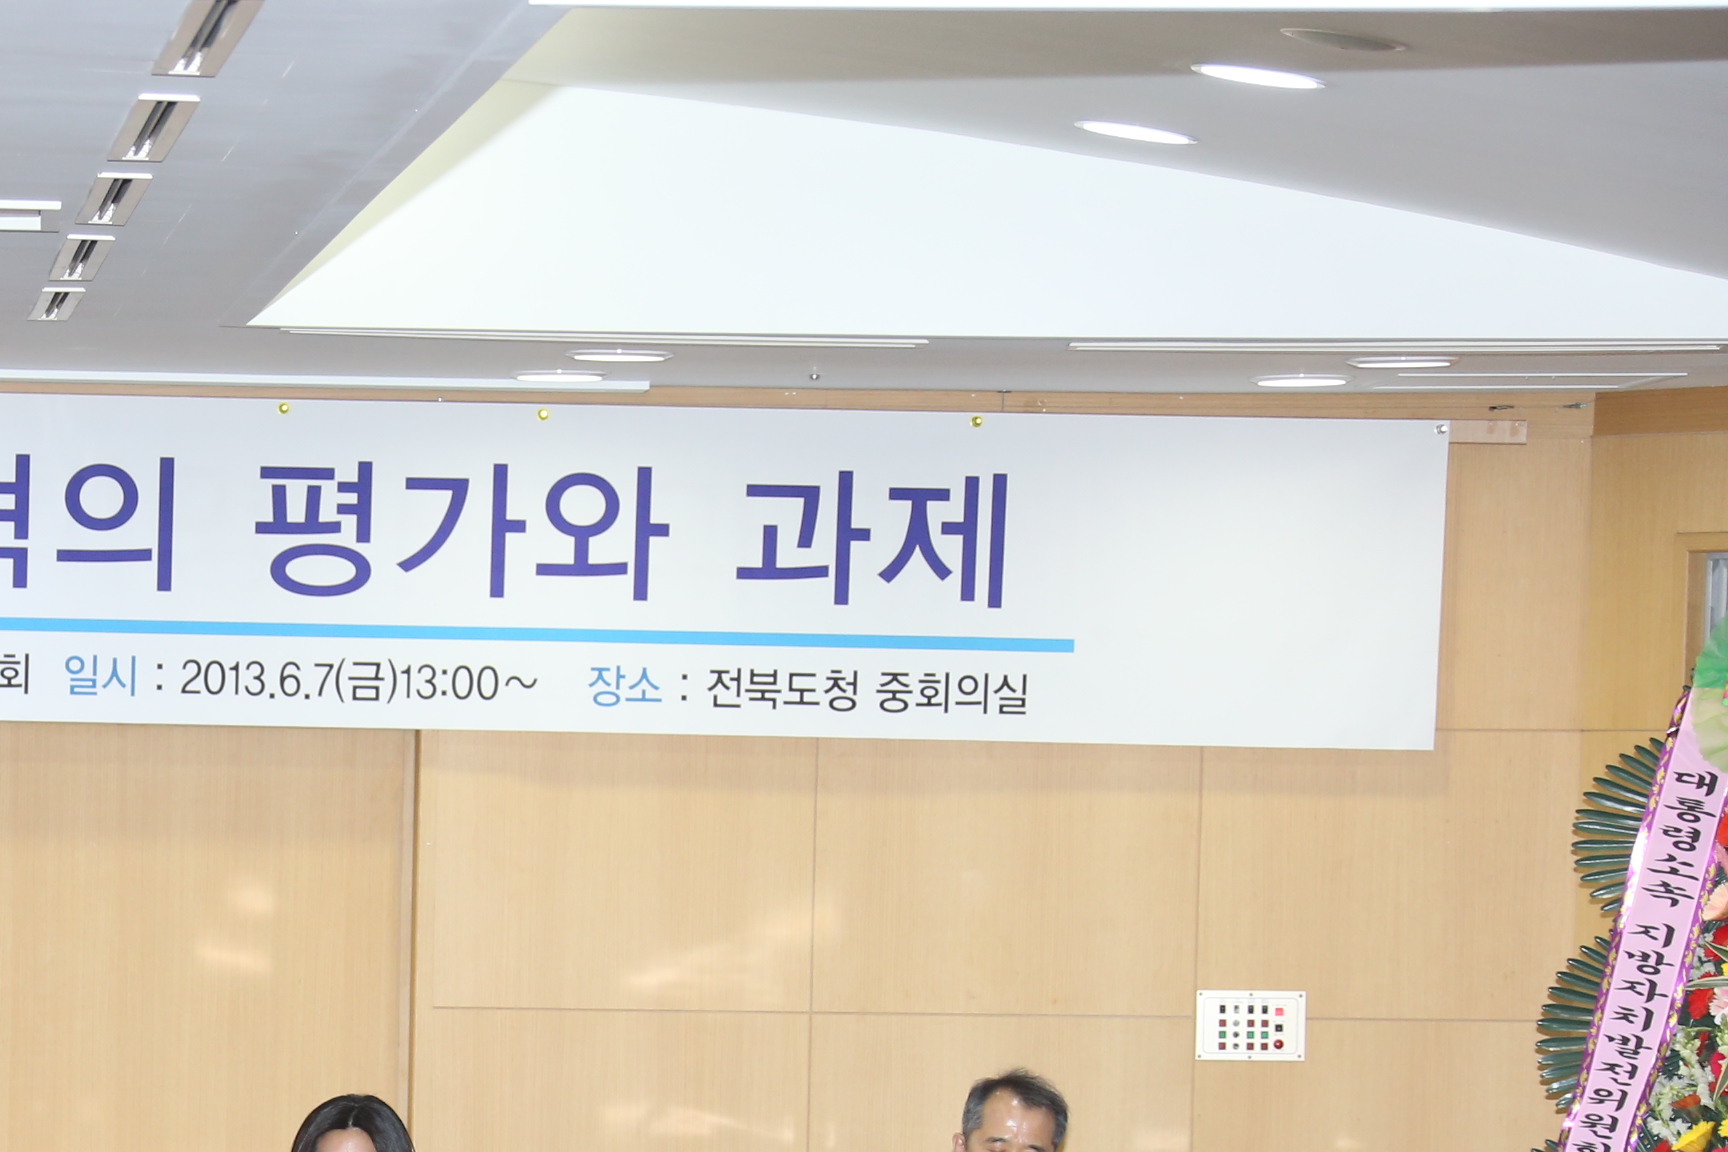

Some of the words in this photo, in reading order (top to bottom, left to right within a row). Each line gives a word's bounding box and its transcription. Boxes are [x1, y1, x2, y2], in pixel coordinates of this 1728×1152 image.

[254, 460, 671, 602] 평가와
[735, 470, 1008, 609] 과제
[64, 654, 136, 697] 일시
[588, 665, 663, 707] 장소
[707, 667, 859, 713] 전북도청
[875, 671, 1028, 716] 중회의실
[1641, 770, 1719, 908] 대통령소속
